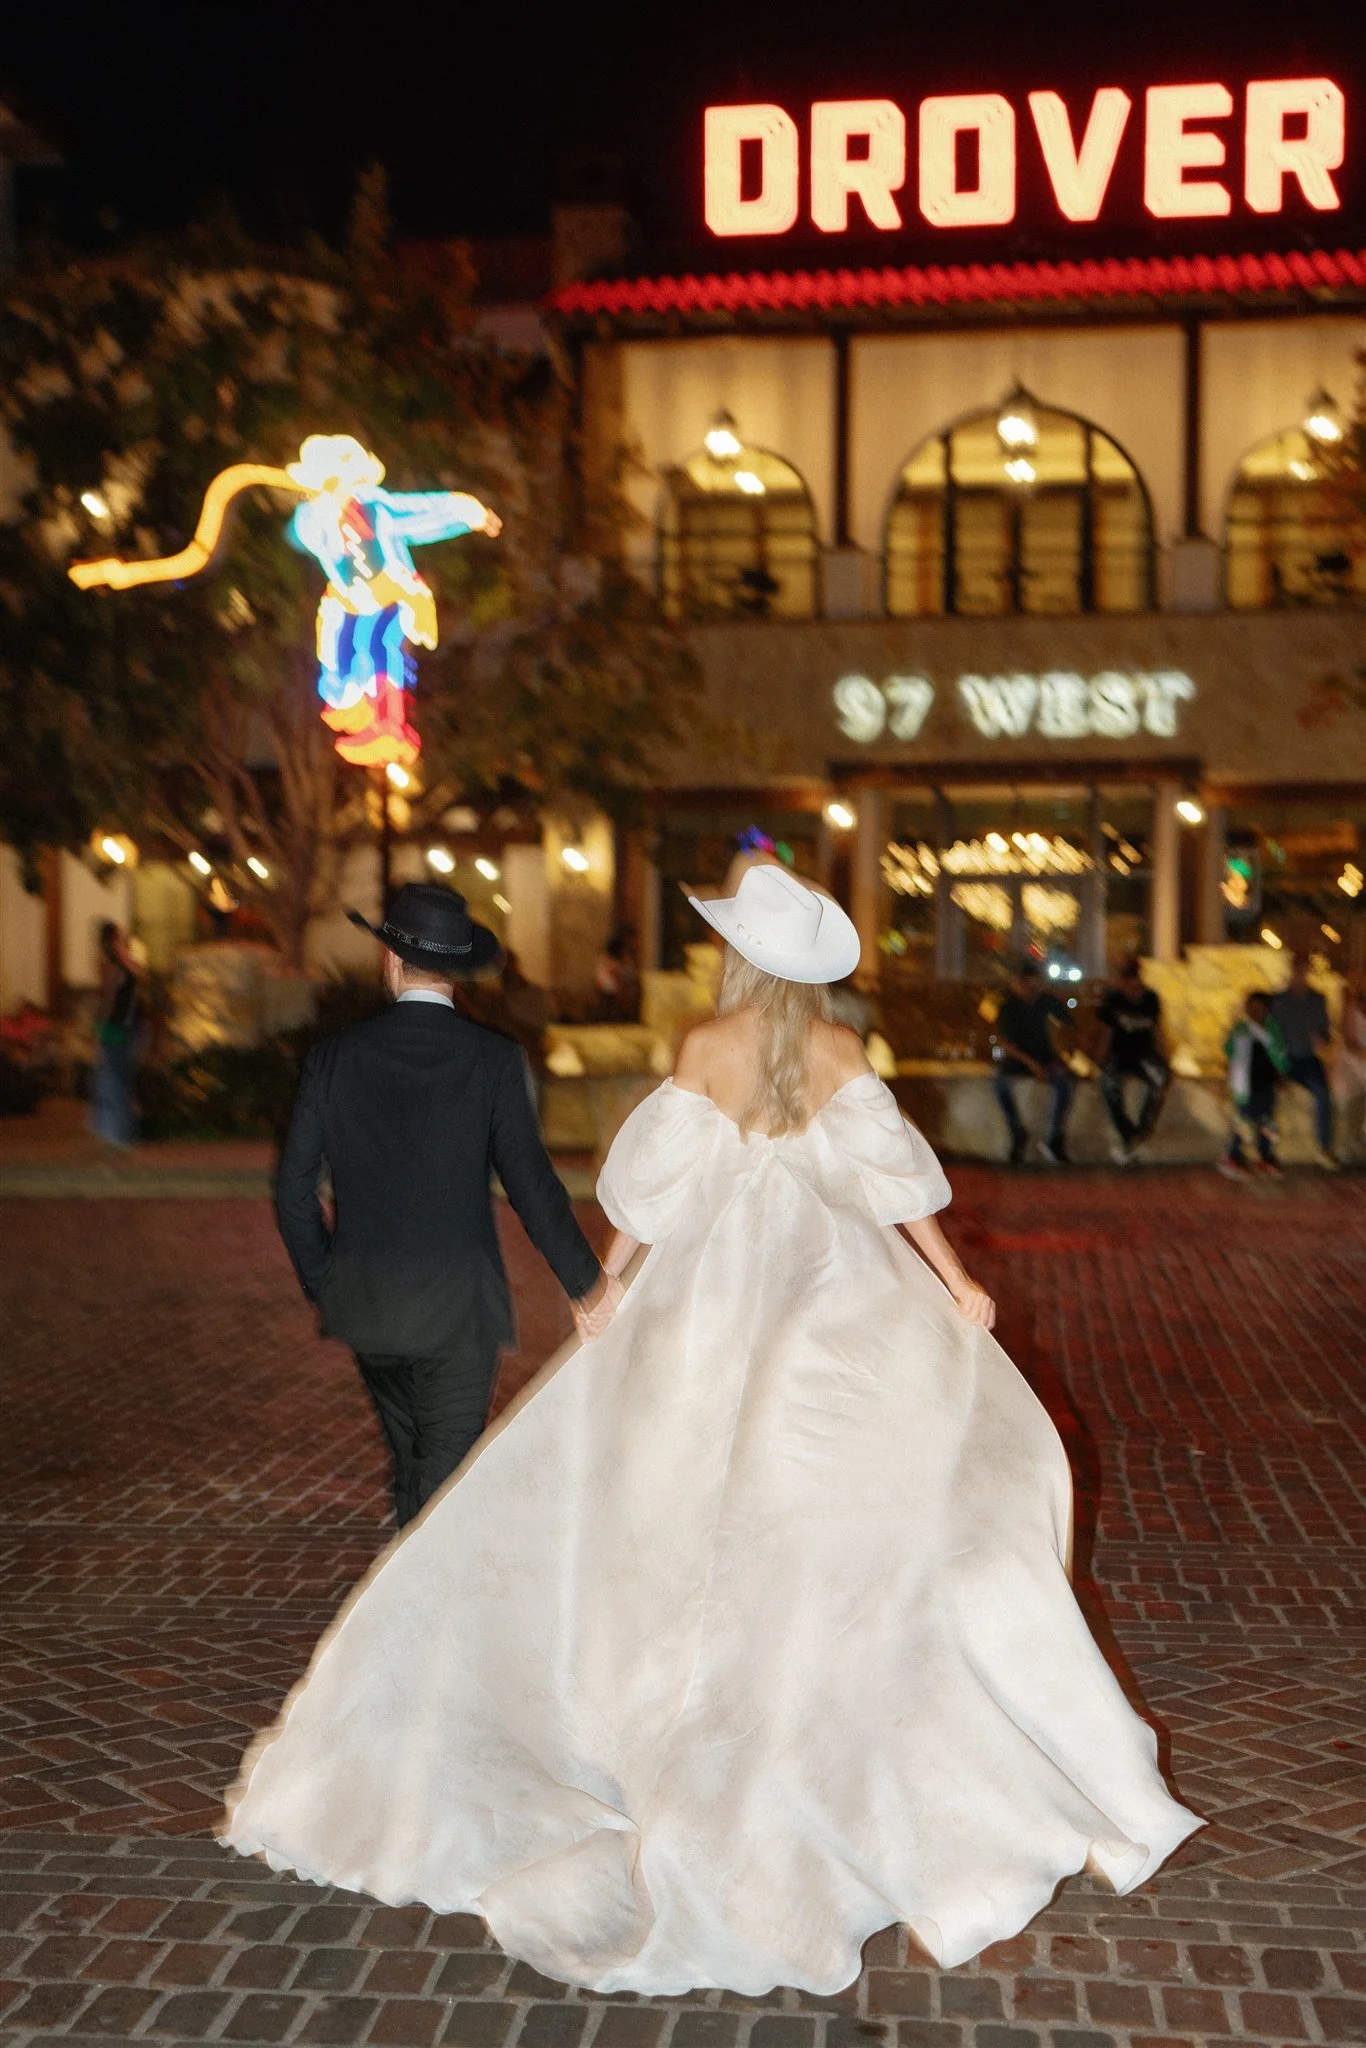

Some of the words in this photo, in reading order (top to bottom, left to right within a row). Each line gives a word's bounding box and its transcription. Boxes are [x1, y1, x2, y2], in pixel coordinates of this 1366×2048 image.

[703, 77, 1345, 237] DROVER
[833, 673, 934, 743] 97
[957, 670, 1196, 739] WEST
